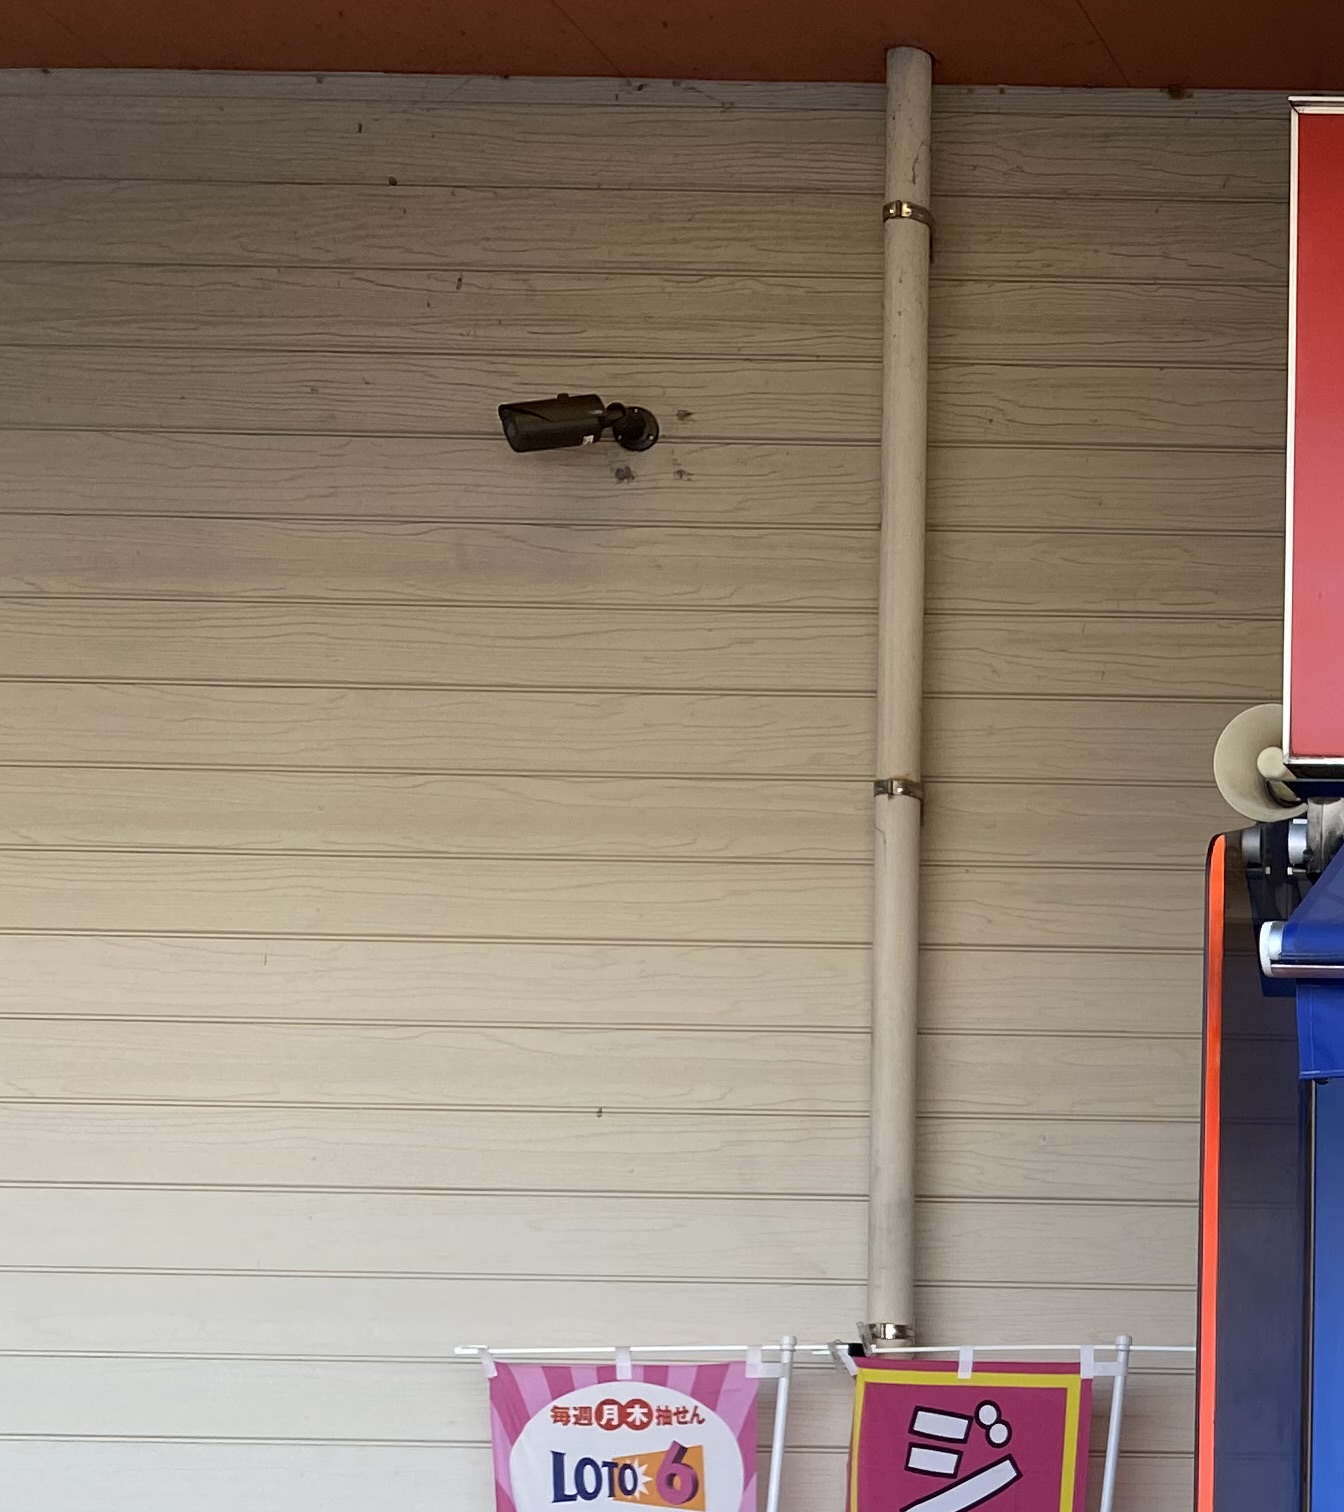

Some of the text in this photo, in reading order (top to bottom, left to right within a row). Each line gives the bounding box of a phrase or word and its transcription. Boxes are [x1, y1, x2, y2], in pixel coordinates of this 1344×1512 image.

[551, 1398, 706, 1431] 毎週月木抽せん
[550, 1450, 639, 1504] LOTO
